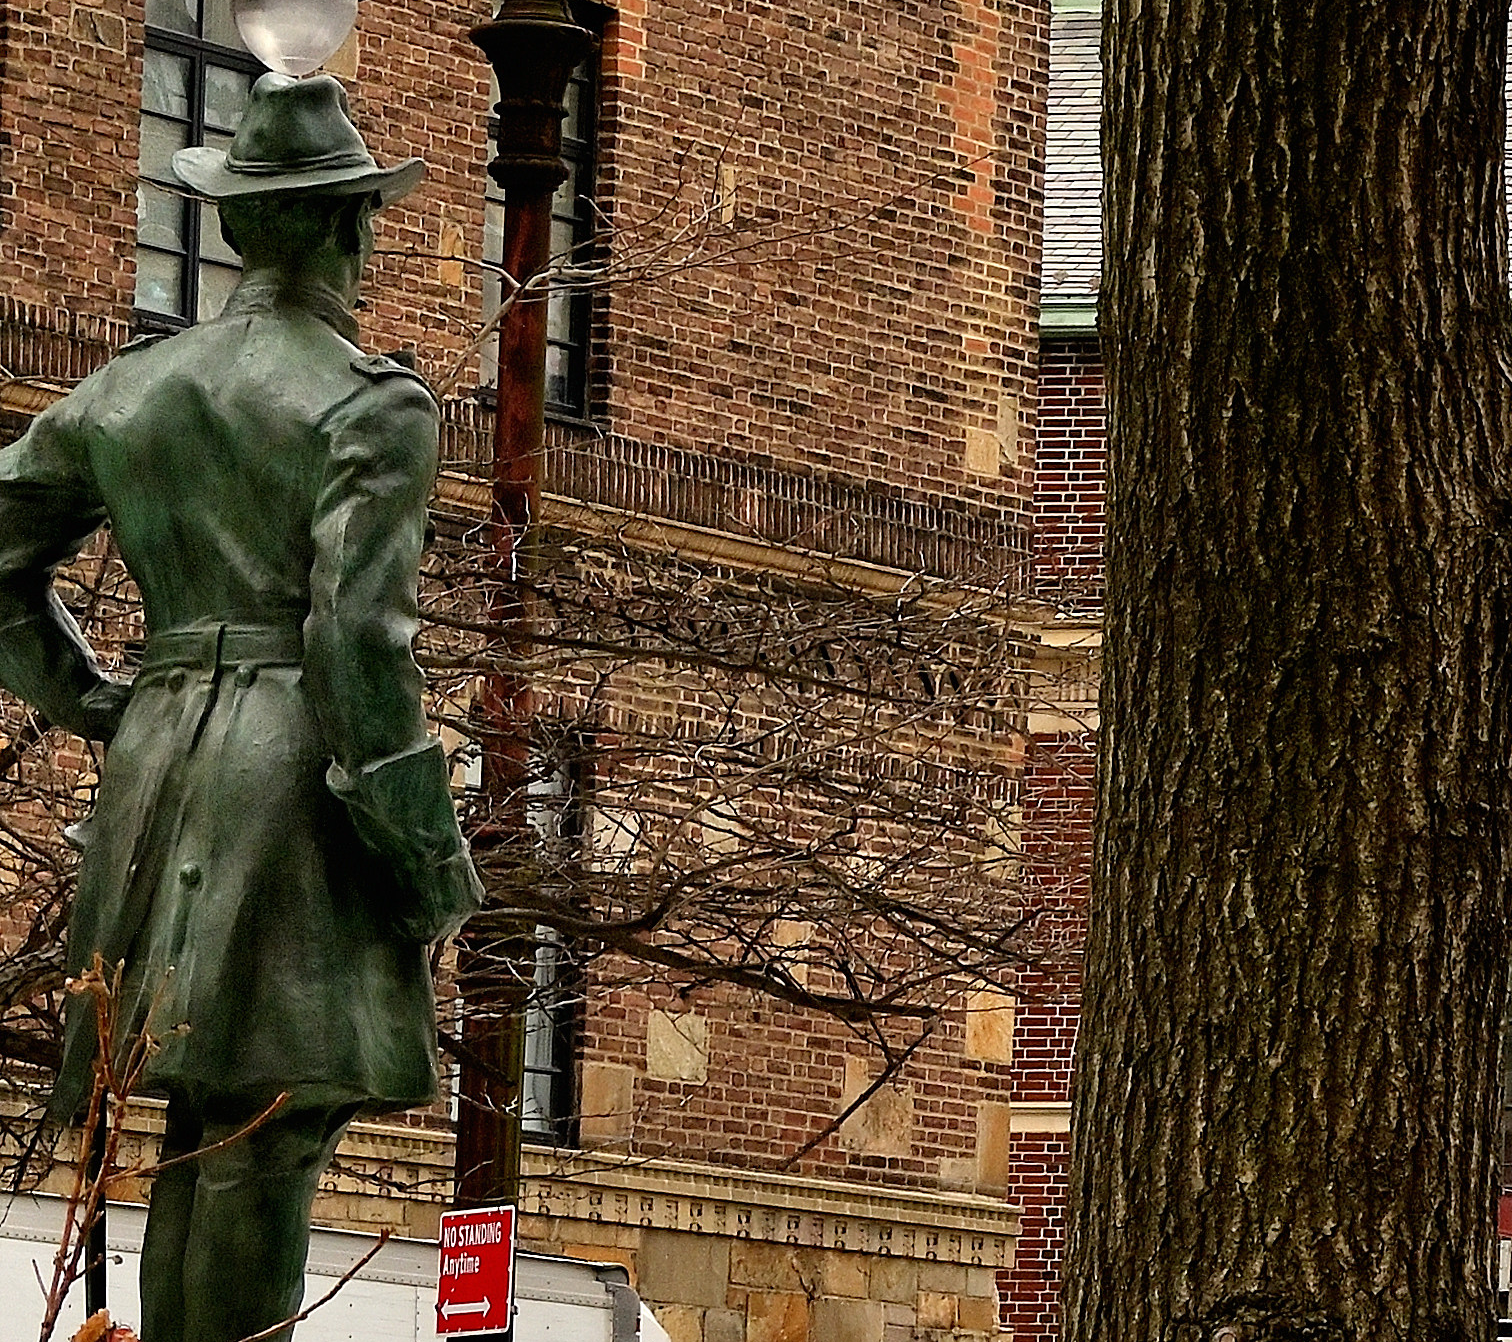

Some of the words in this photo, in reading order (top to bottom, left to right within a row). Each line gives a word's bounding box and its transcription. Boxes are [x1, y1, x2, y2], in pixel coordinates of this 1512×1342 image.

[443, 1226, 457, 1248] NO
[458, 1221, 502, 1247] STANDING
[442, 1252, 480, 1279] Anytime
